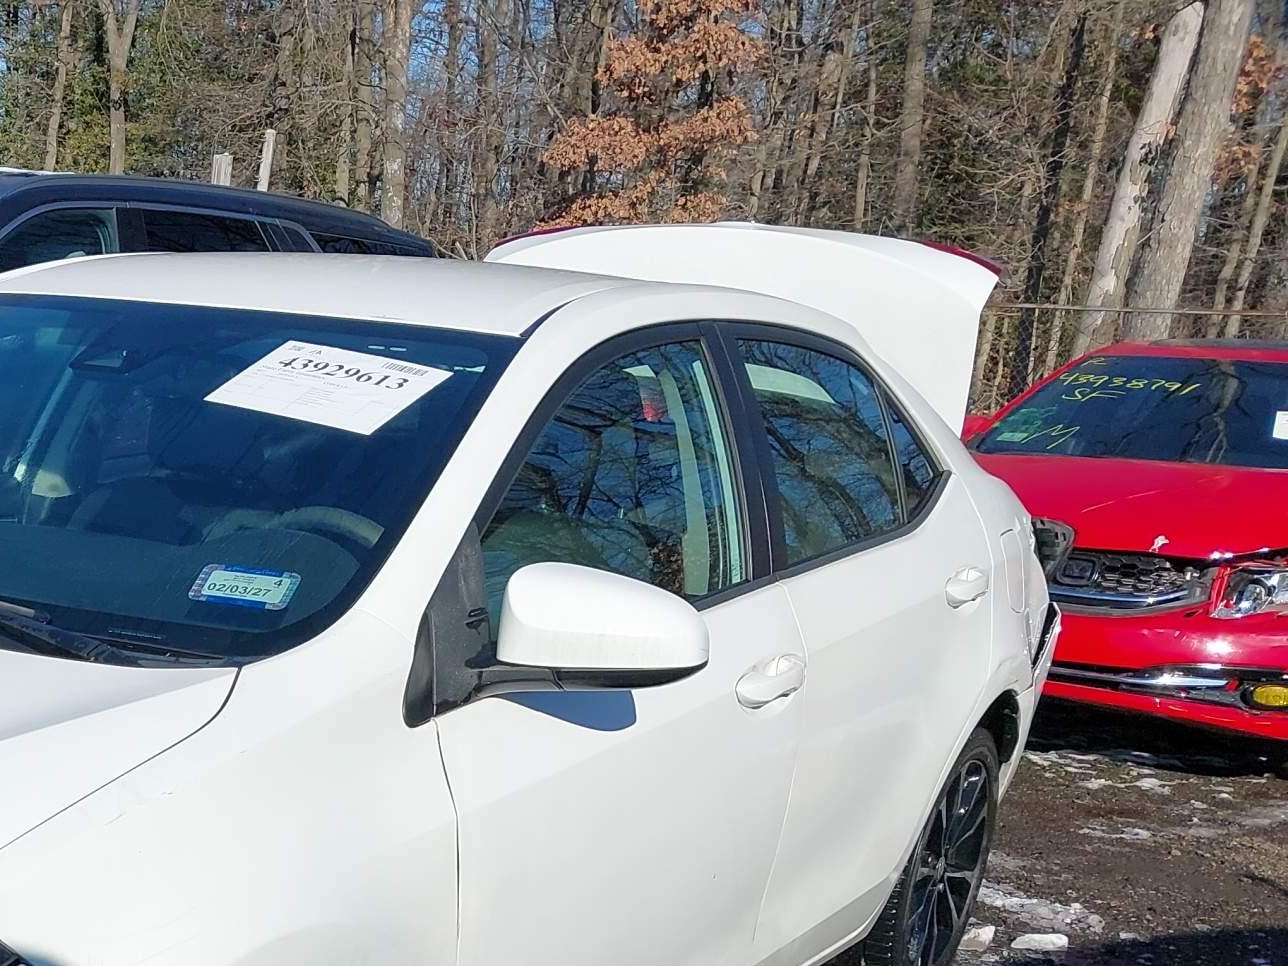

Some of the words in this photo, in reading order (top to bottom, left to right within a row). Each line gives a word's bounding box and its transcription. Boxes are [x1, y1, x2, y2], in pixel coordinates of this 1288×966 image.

[278, 356, 409, 390] 43929613
[1059, 372, 1201, 396] 43938791
[207, 582, 273, 597] 02/03/27
[273, 579, 283, 588] 4
